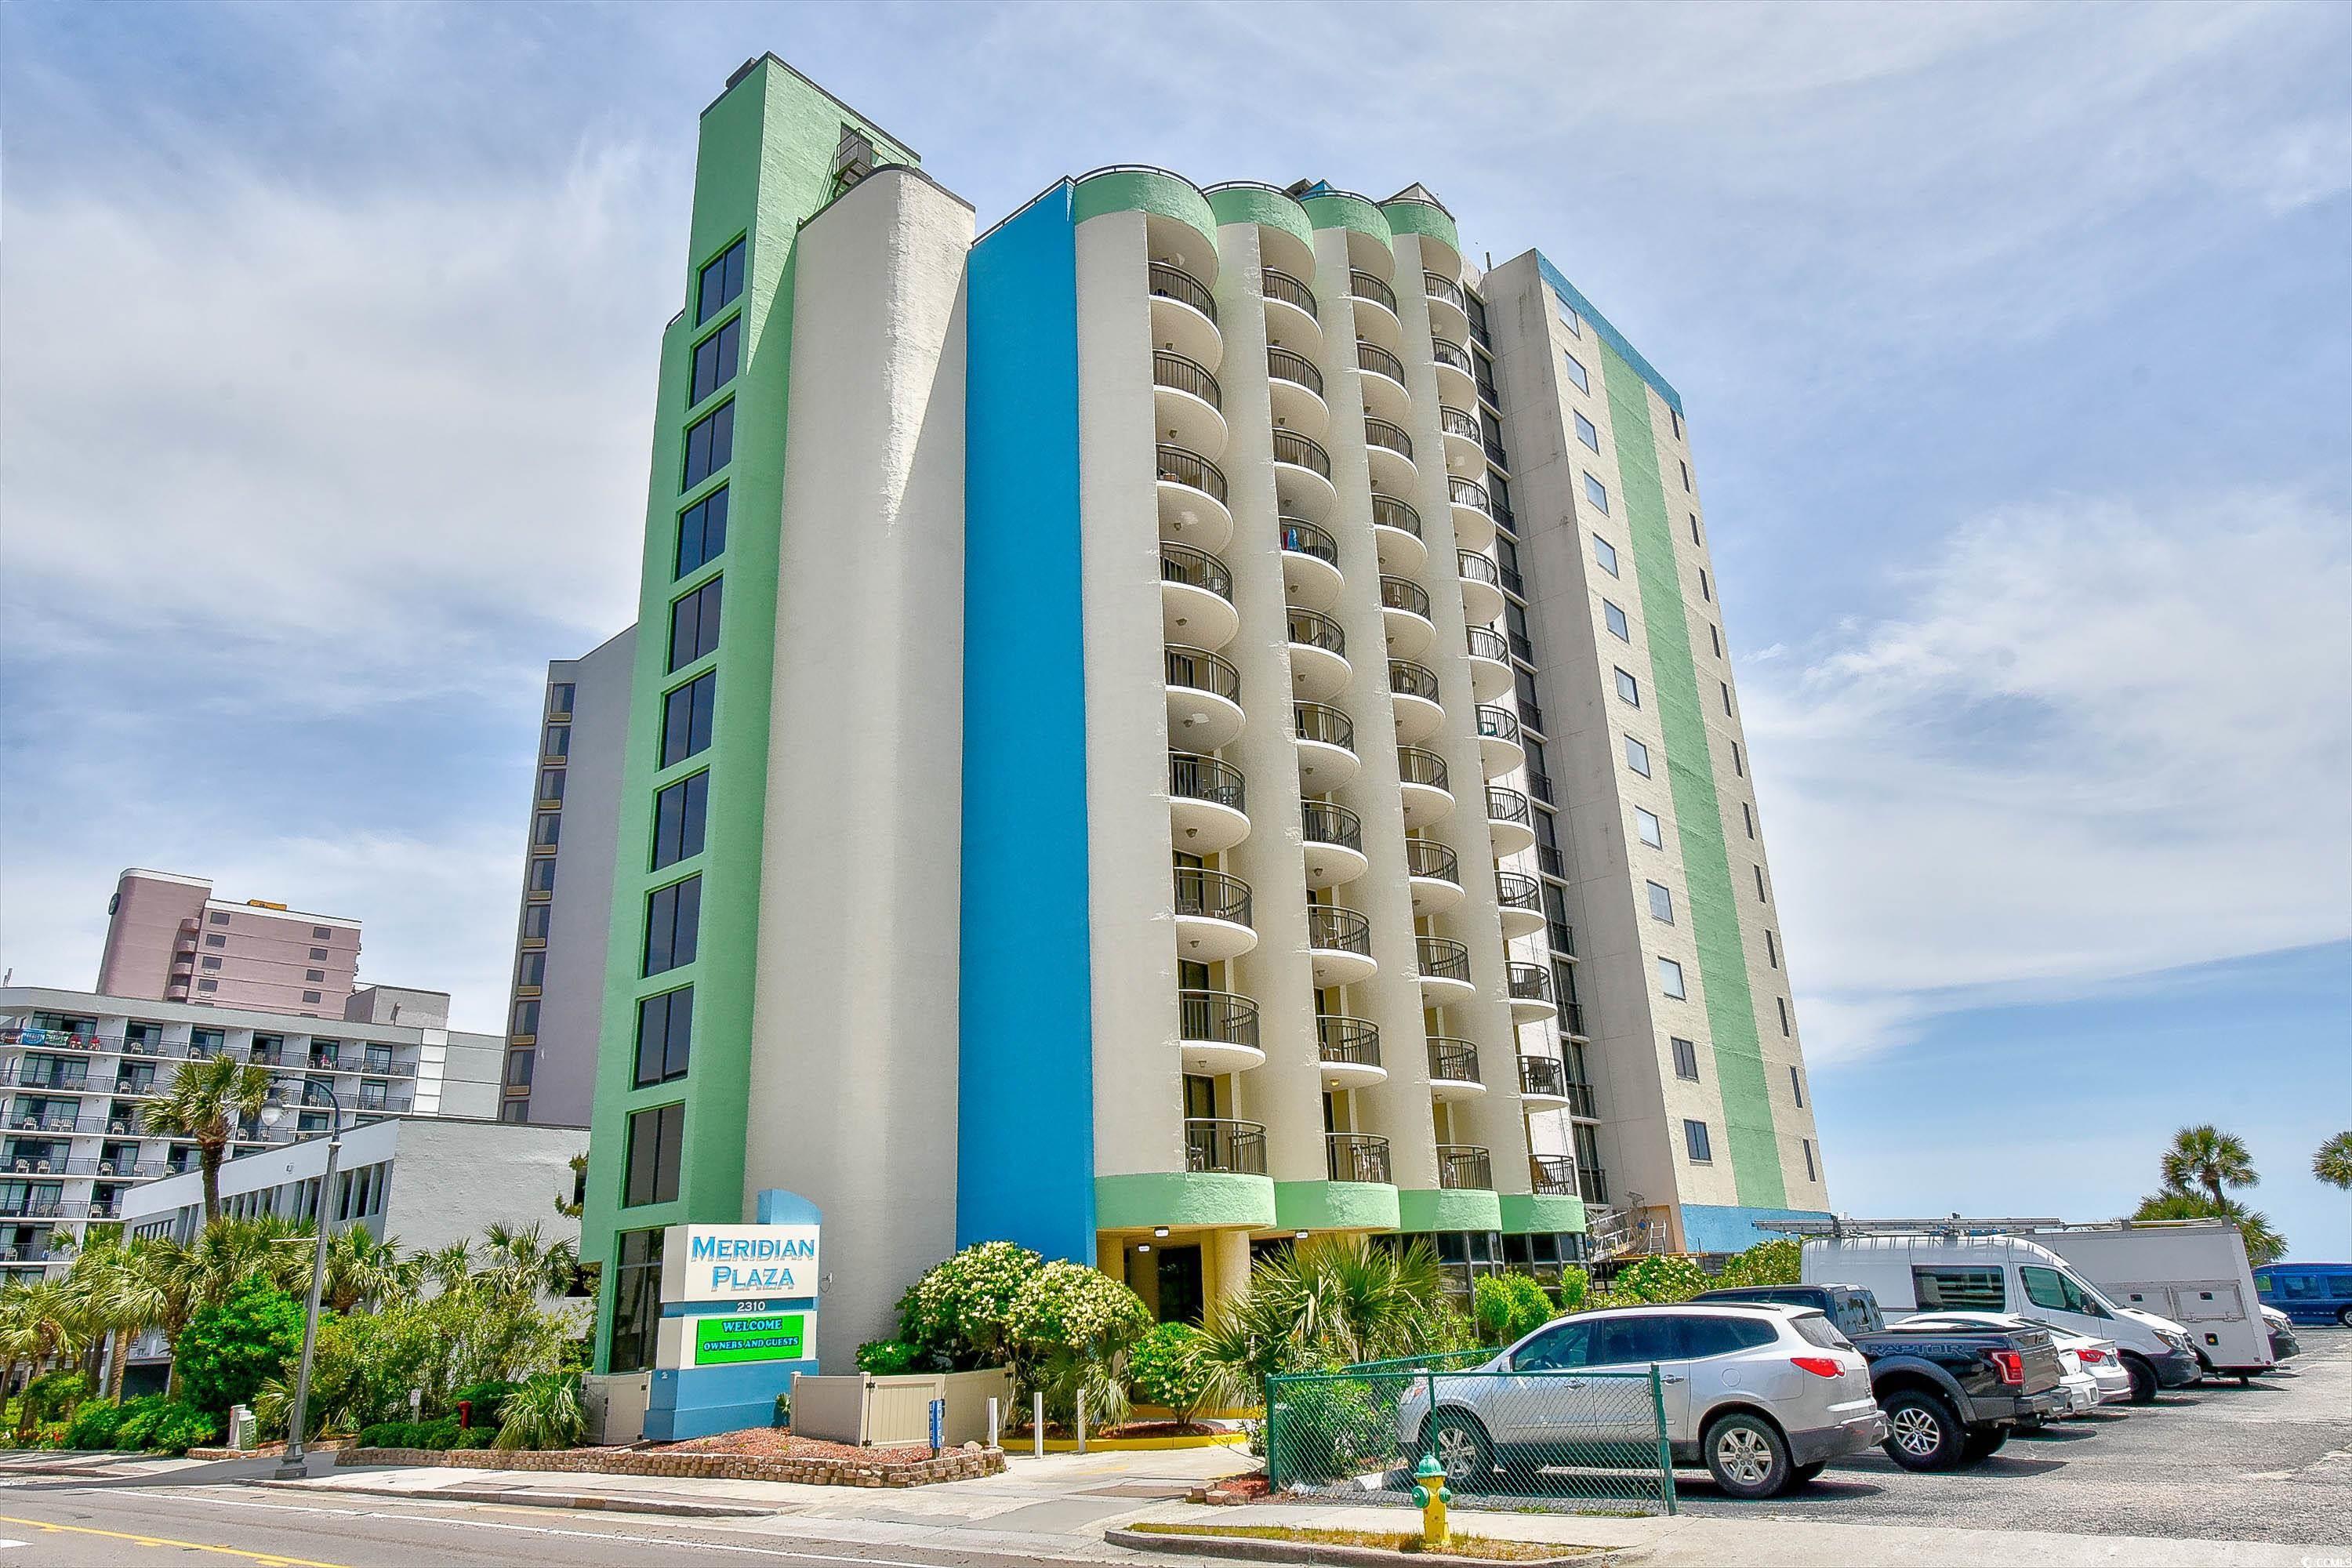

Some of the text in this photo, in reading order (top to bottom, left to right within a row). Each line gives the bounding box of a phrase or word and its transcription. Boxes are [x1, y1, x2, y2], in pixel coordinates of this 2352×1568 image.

[710, 1265, 795, 1292] PLAZA
[737, 1301, 766, 1312] 2310
[723, 1319, 782, 1332] WELCOME
[703, 1336, 798, 1351] OWNERS AND GUESTS
[1866, 1343, 1970, 1359] RAPTOR
